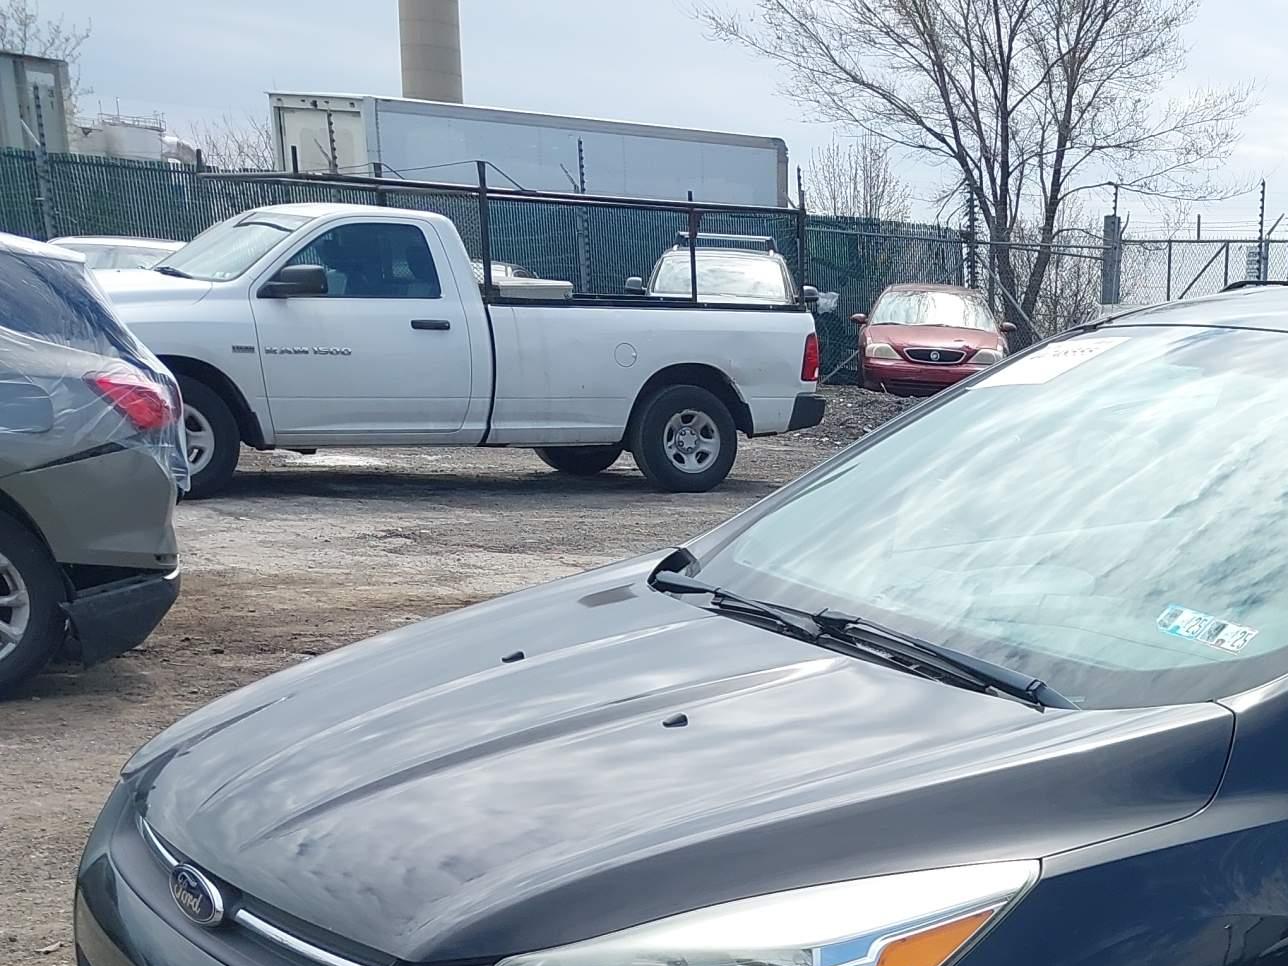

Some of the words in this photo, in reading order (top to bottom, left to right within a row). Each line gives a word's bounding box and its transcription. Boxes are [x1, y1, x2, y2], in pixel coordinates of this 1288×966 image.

[264, 345, 309, 355] RAM
[312, 345, 352, 355] 1500
[174, 871, 203, 914] Ford
